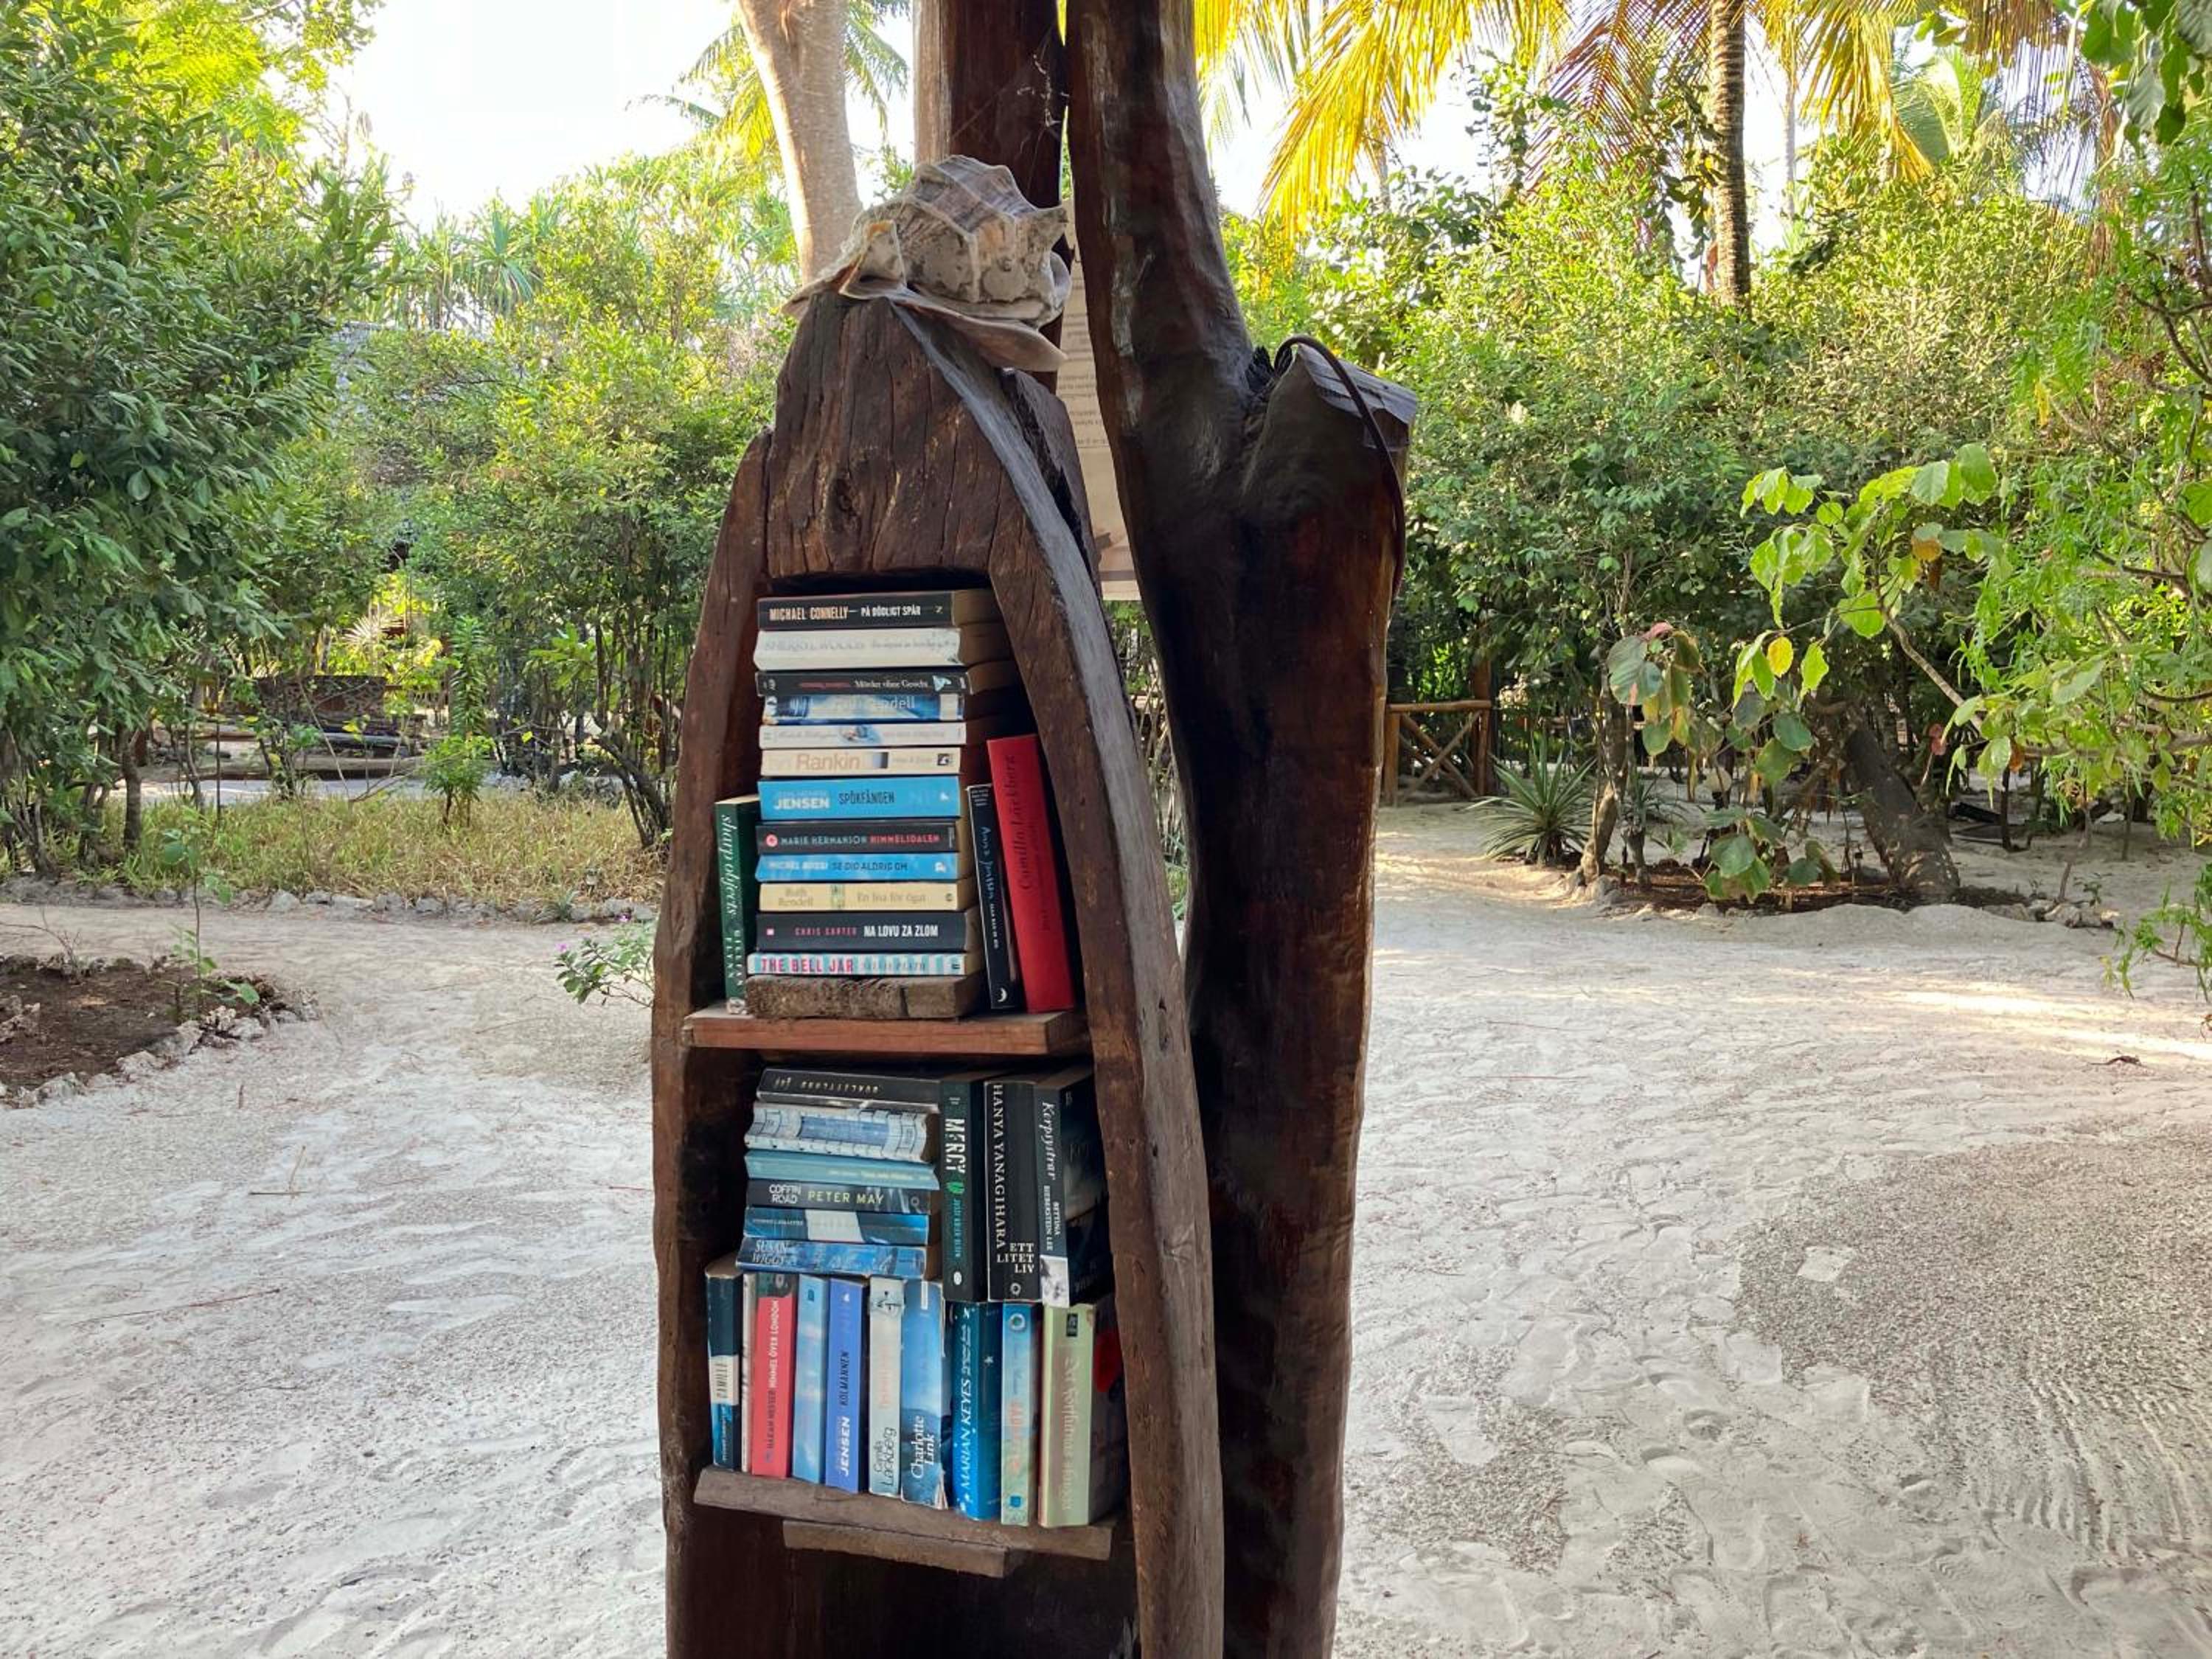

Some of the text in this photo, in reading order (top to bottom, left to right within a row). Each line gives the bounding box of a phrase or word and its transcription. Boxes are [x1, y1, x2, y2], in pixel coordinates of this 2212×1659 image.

[769, 604, 921, 621] MICHAEL CONNELLY PÅ DÖDLIGT SPÅR
[796, 751, 860, 771] Rankin
[774, 797, 830, 810] JENSEN
[838, 789, 894, 805] SPÖKFÅNGEN
[781, 834, 940, 845] MARIE HERMANSON HIMMELSDALEN
[981, 824, 991, 857] Anna
[720, 813, 740, 916] sharp objects
[864, 925, 876, 937] NA
[878, 925, 899, 937] LOVU
[901, 925, 913, 936] ZA
[914, 925, 939, 937] ZLOM
[726, 937, 735, 978] FLYNN
[762, 959, 785, 973] THE
[791, 959, 821, 973] BELL
[829, 959, 853, 973] JAR
[945, 1118, 965, 1174] MERCY
[993, 1084, 1006, 1249] HANYA YANAGIHARA
[769, 1183, 801, 1194] COFFIN
[771, 1193, 798, 1204] ROAD
[807, 1190, 885, 1204] PETER MAY
[1009, 1242, 1034, 1253] ETT
[996, 1253, 1034, 1263] LITET
[1015, 1263, 1034, 1273] LIV
[770, 1299, 779, 1335] LONDON
[768, 1335, 779, 1357] ÖVER
[961, 1378, 972, 1426] KEYES
[838, 1351, 850, 1477] JENSEN KOLMANNEN
[911, 1415, 925, 1478] Charlotte
[923, 1433, 935, 1465] Link
[961, 1427, 972, 1491] MARIAN
